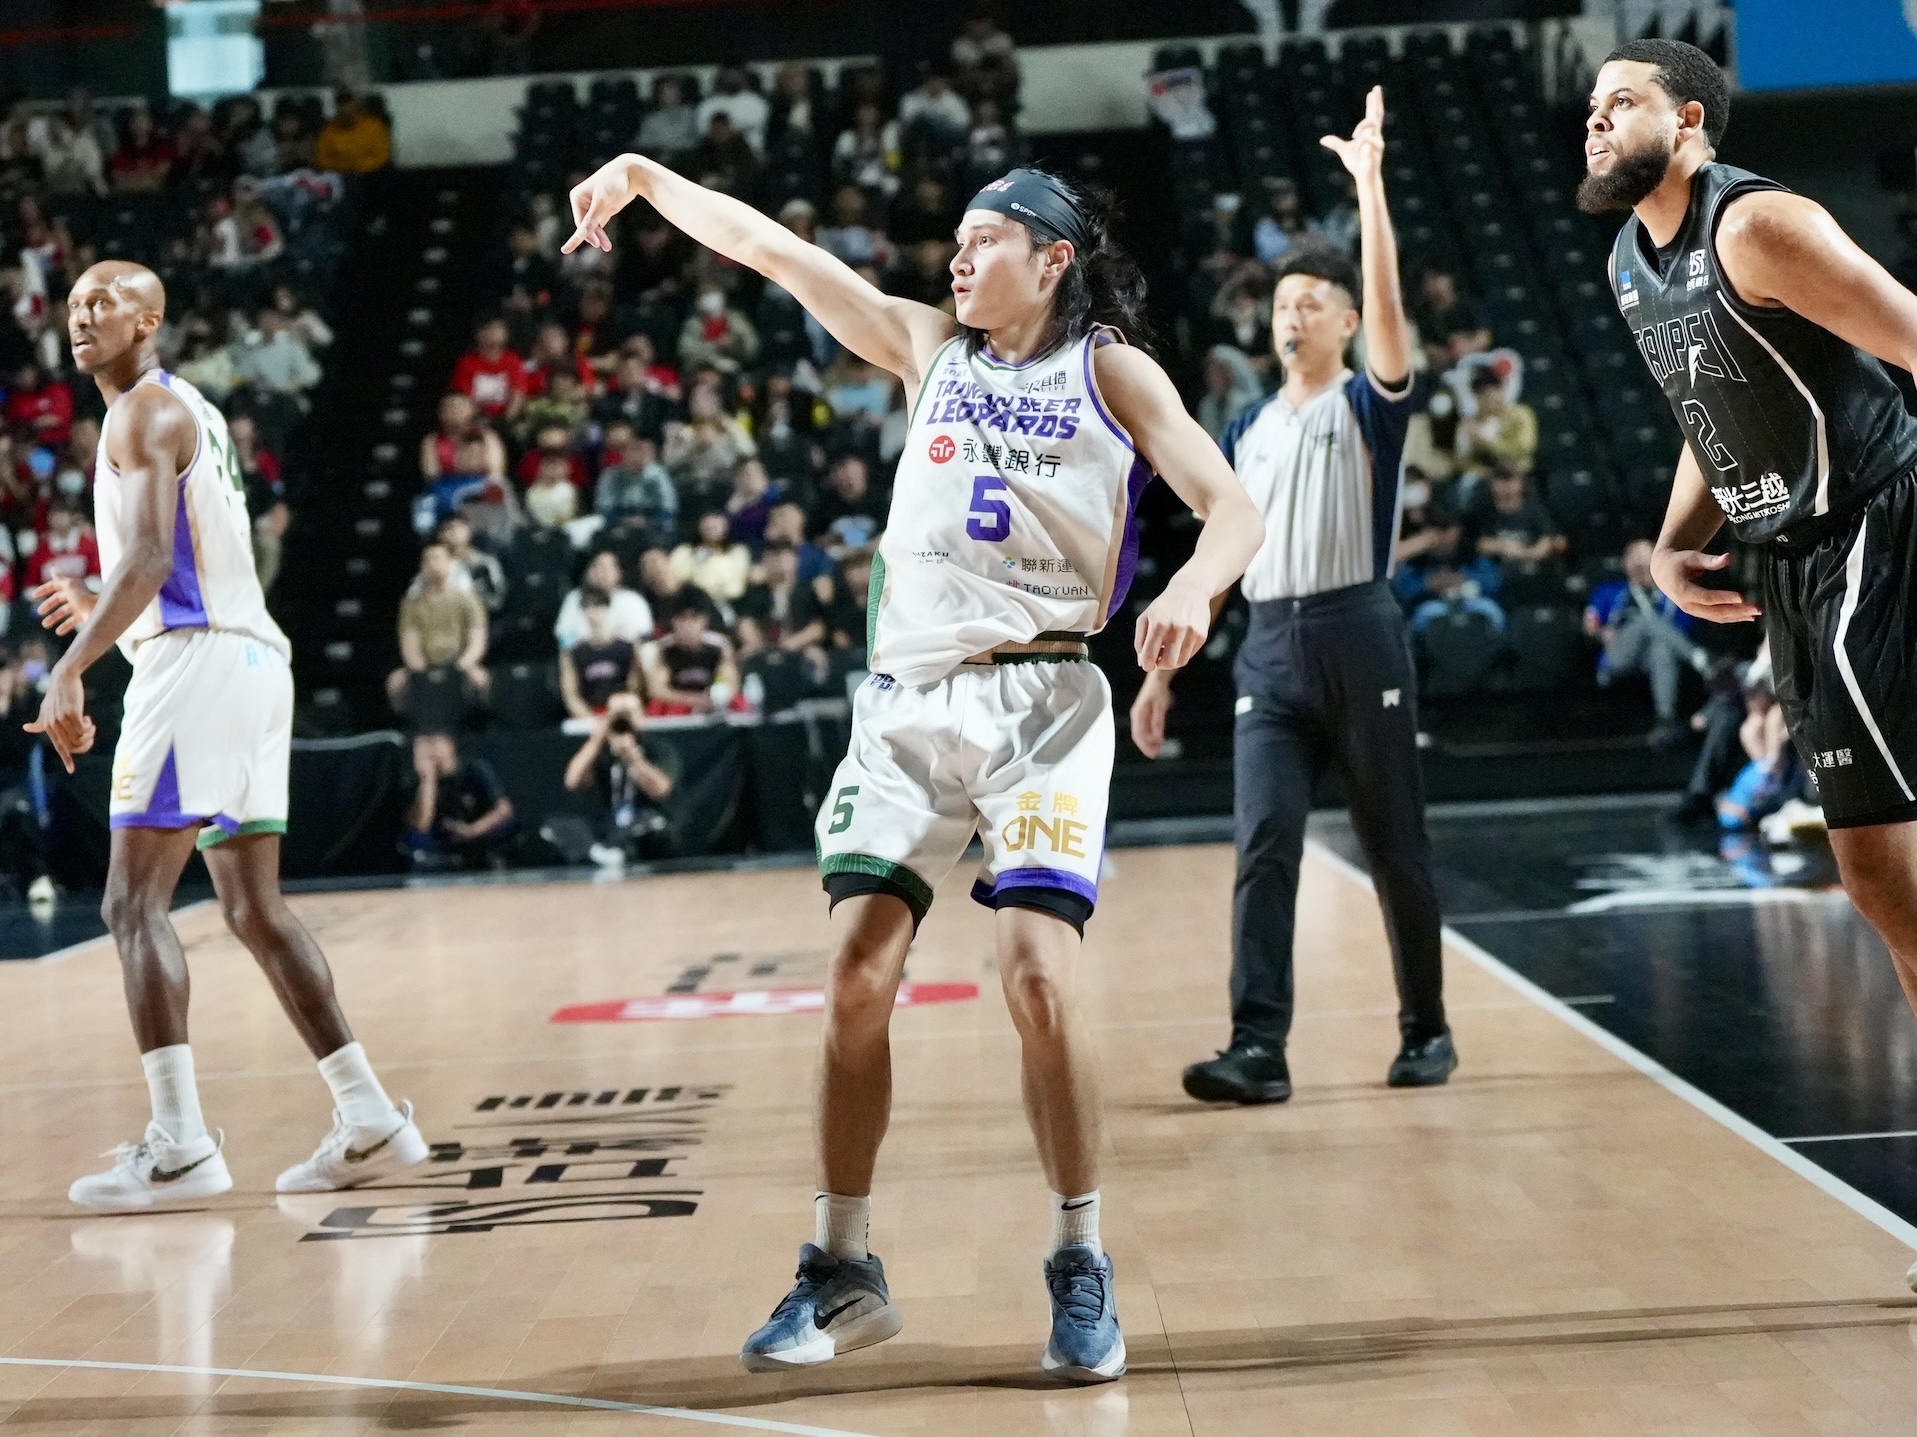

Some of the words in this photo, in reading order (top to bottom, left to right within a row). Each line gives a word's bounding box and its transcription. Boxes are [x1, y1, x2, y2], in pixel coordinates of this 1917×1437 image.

[926, 398, 1081, 440] LEOPARDS
[1016, 396, 1082, 414] BEER
[1681, 399, 1739, 472] 2
[963, 438, 1062, 478] 永豐銀行
[966, 475, 1011, 543] 5
[1021, 557, 1079, 573] 聯新運
[1023, 583, 1088, 596] TAOYUAN
[828, 785, 860, 835] 5
[1015, 790, 1080, 816] 金牌
[1001, 815, 1089, 859] ONE
